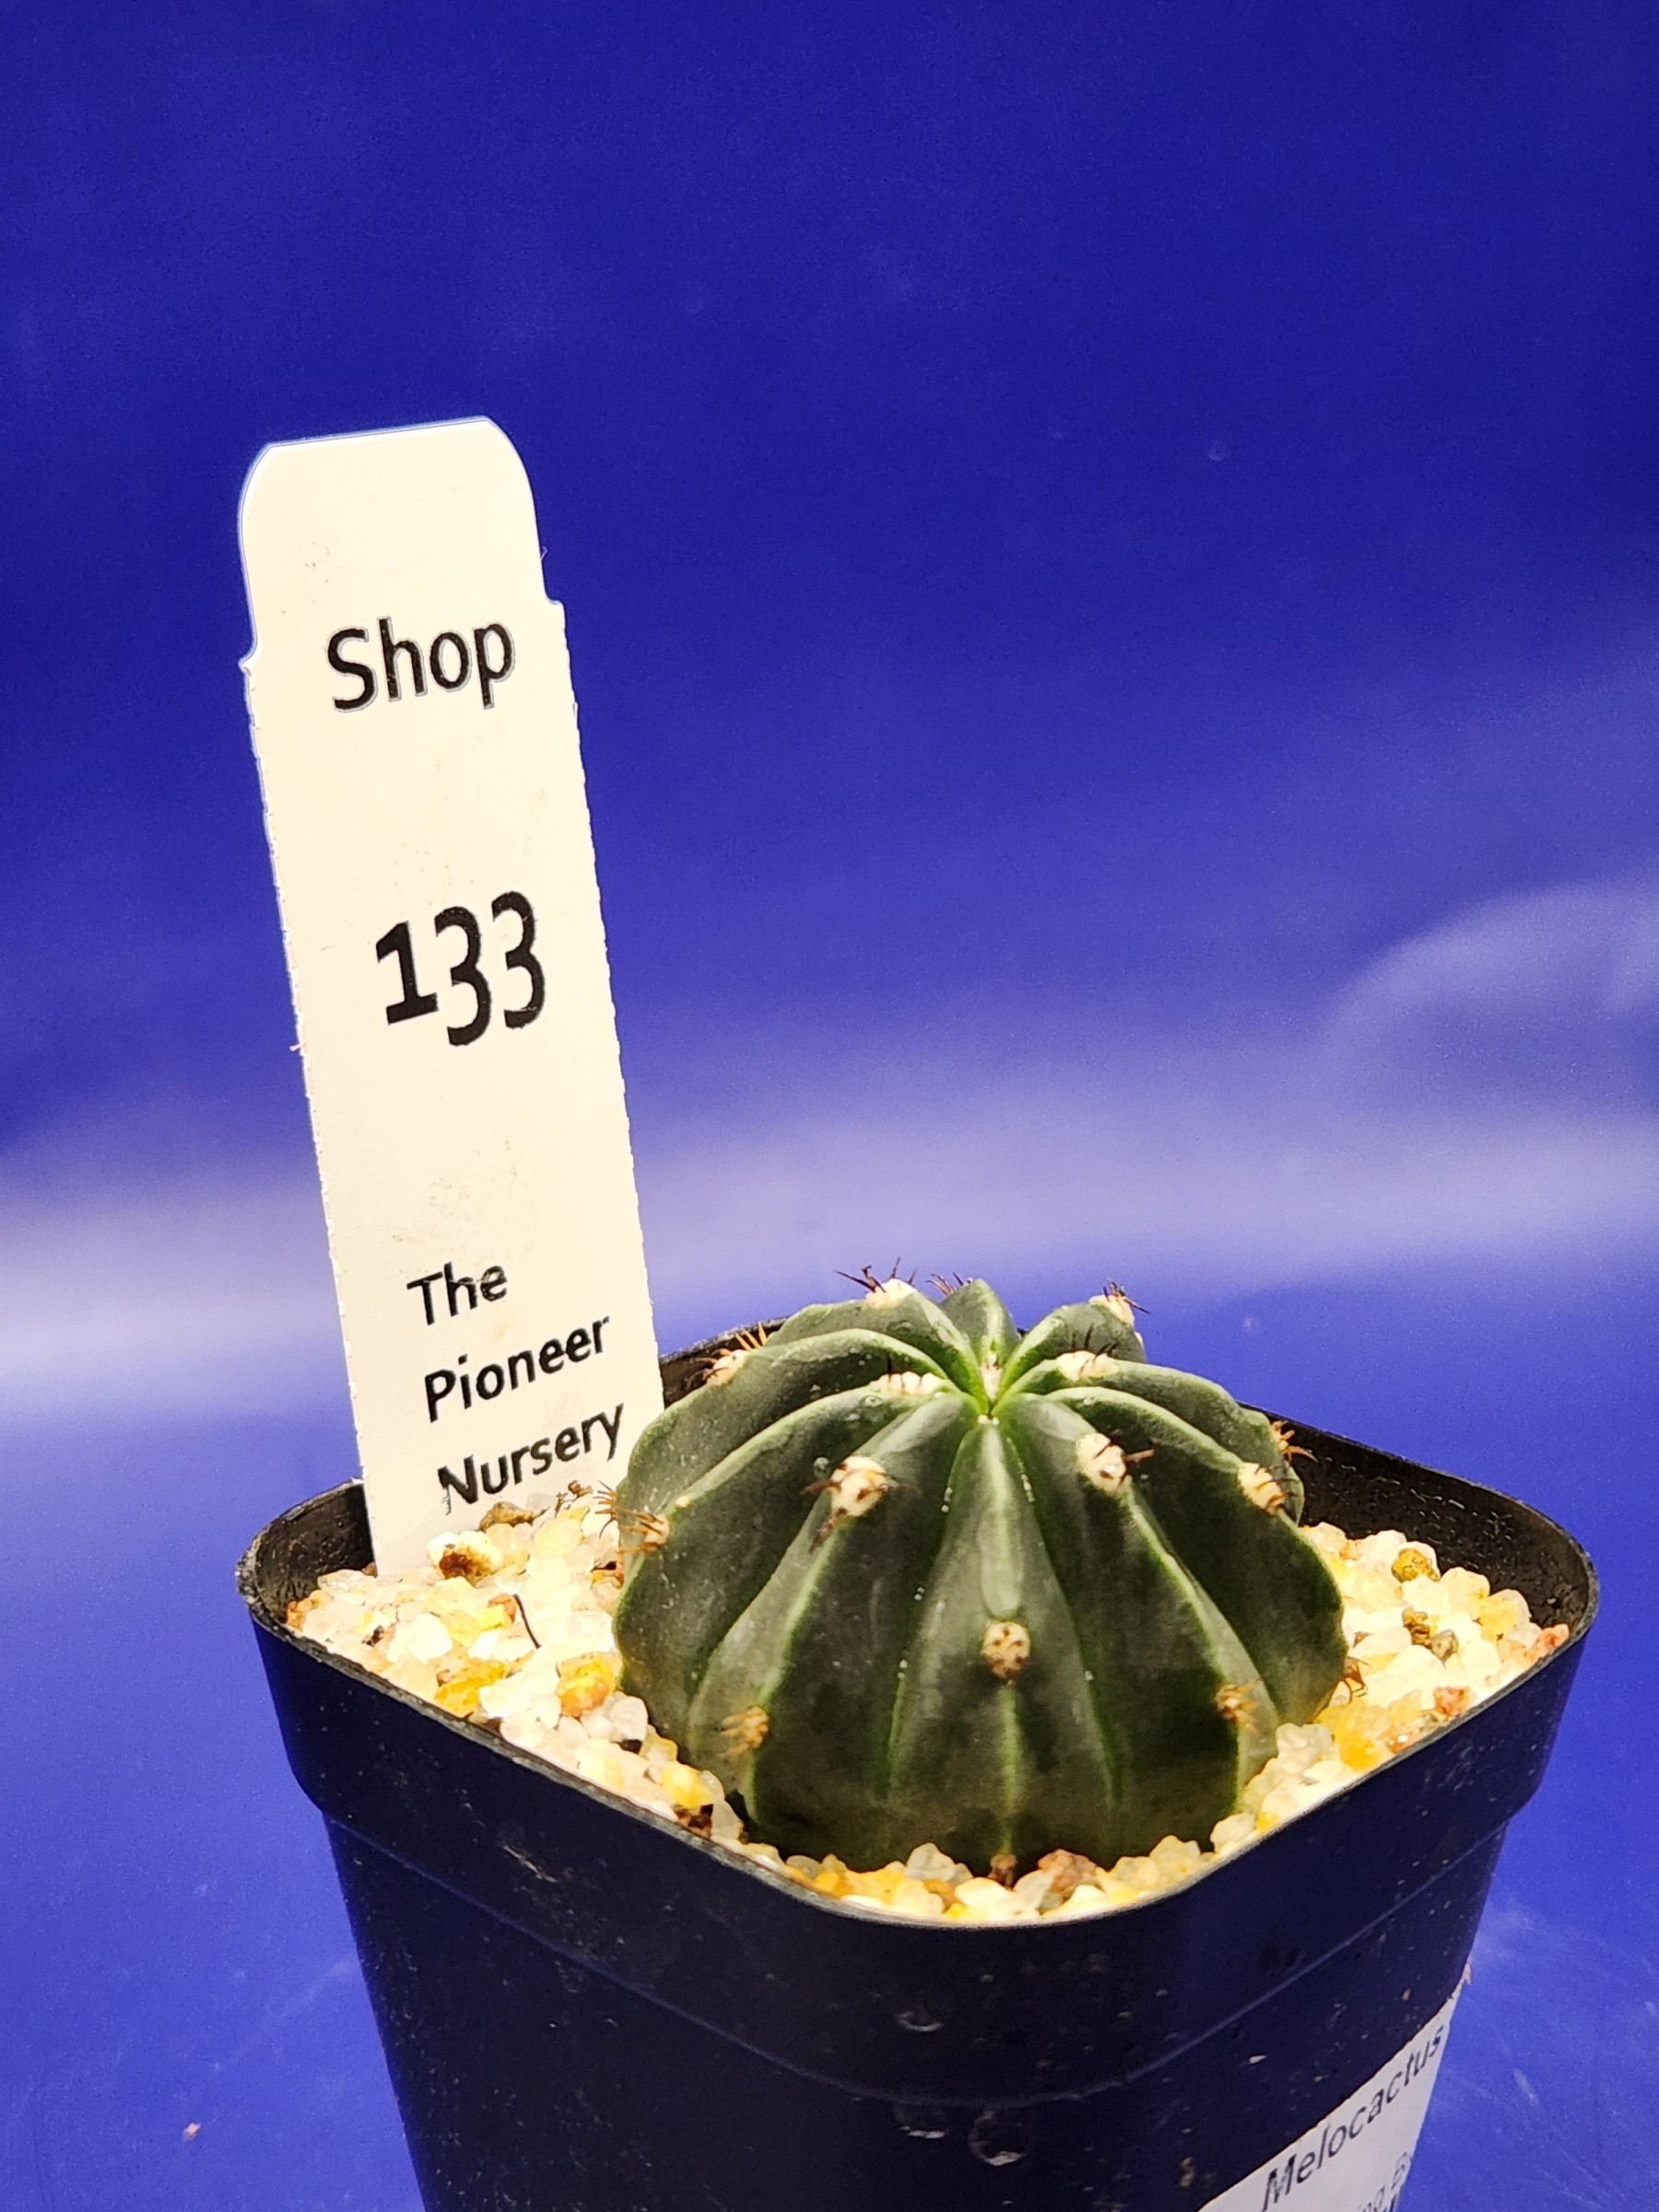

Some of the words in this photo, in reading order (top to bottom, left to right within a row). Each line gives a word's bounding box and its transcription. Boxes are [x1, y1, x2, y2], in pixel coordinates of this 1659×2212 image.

[327, 617, 514, 712] Shop
[376, 891, 546, 1046] 133
[406, 1262, 508, 1325] The
[425, 1316, 610, 1423] Pioneer
[437, 1403, 624, 1516] Nursery
[1262, 2025, 1444, 2212] Melocactus
